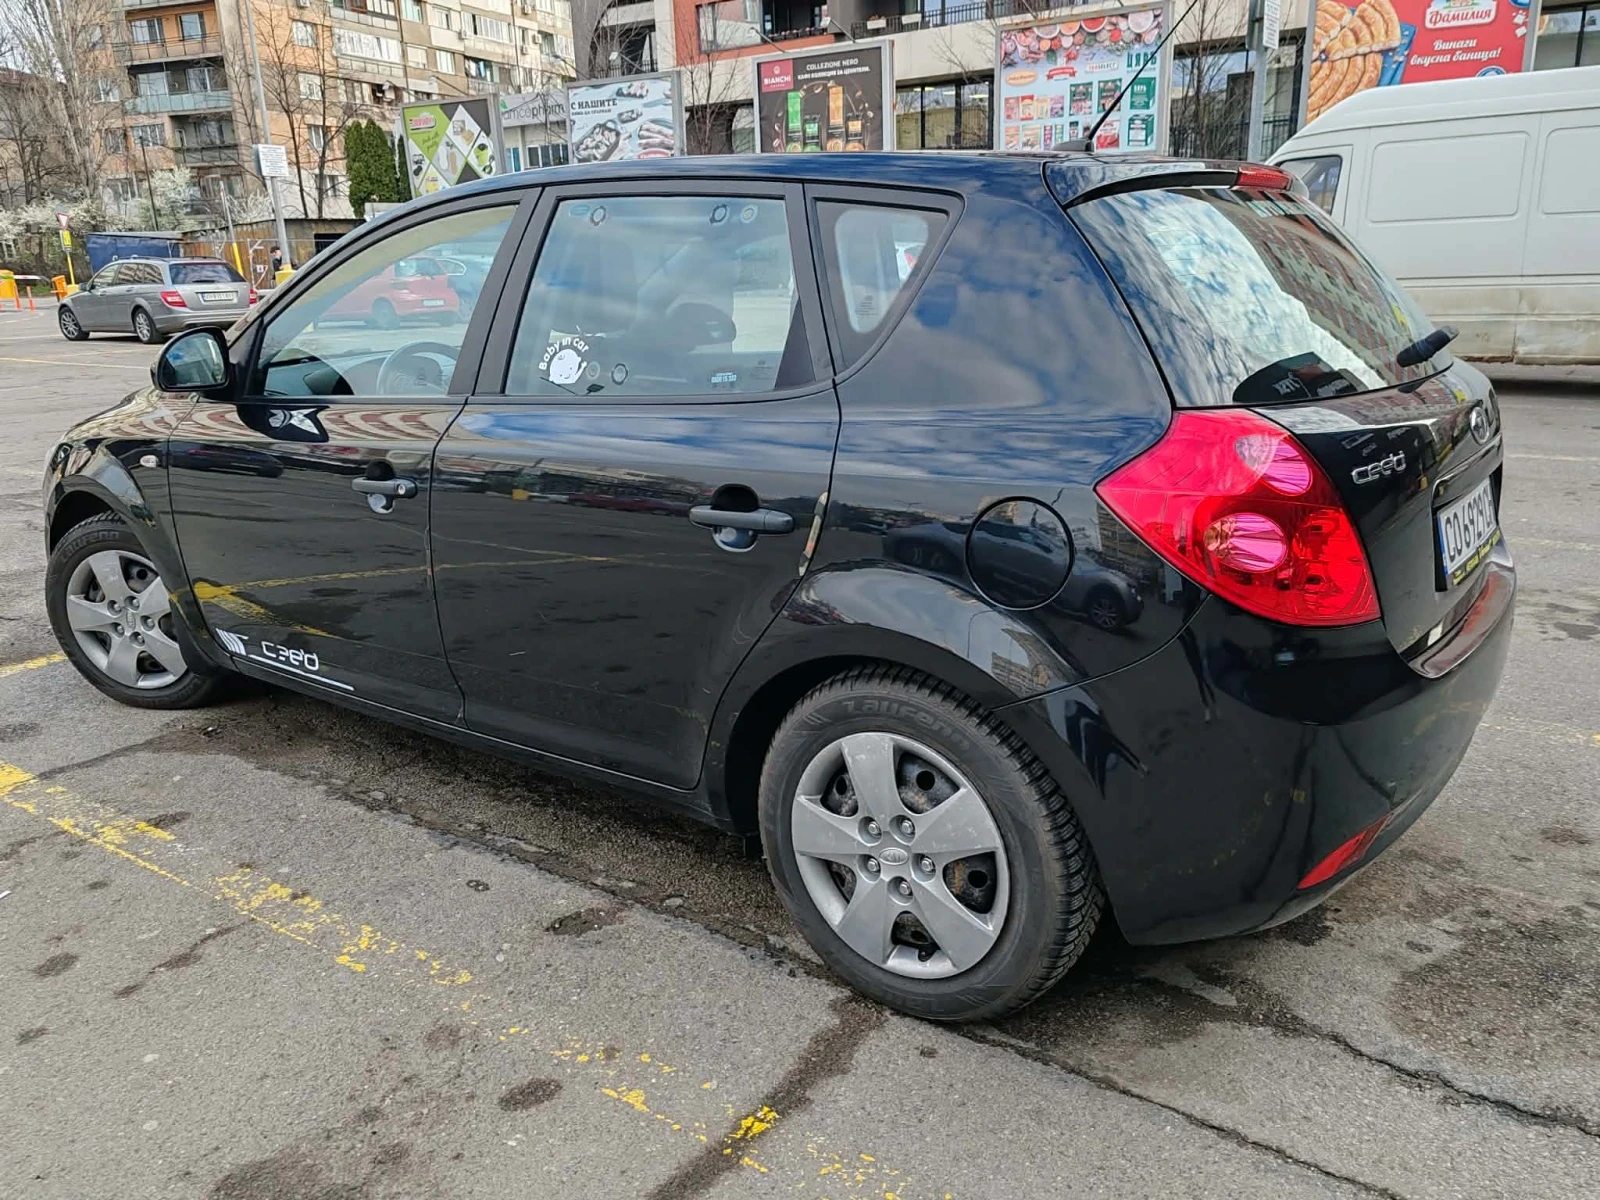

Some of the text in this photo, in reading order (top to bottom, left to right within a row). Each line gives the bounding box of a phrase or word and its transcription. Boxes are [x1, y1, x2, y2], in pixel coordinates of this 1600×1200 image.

[1429, 9, 1492, 26] Фамилия
[1433, 38, 1478, 51] Винаги
[1410, 47, 1502, 67] вкусна баница!
[806, 58, 859, 71] COLLEZIONE NERO
[764, 74, 791, 85] BIANCHI
[570, 98, 618, 110] С НАШИТЕ
[538, 336, 590, 371] Baby in car
